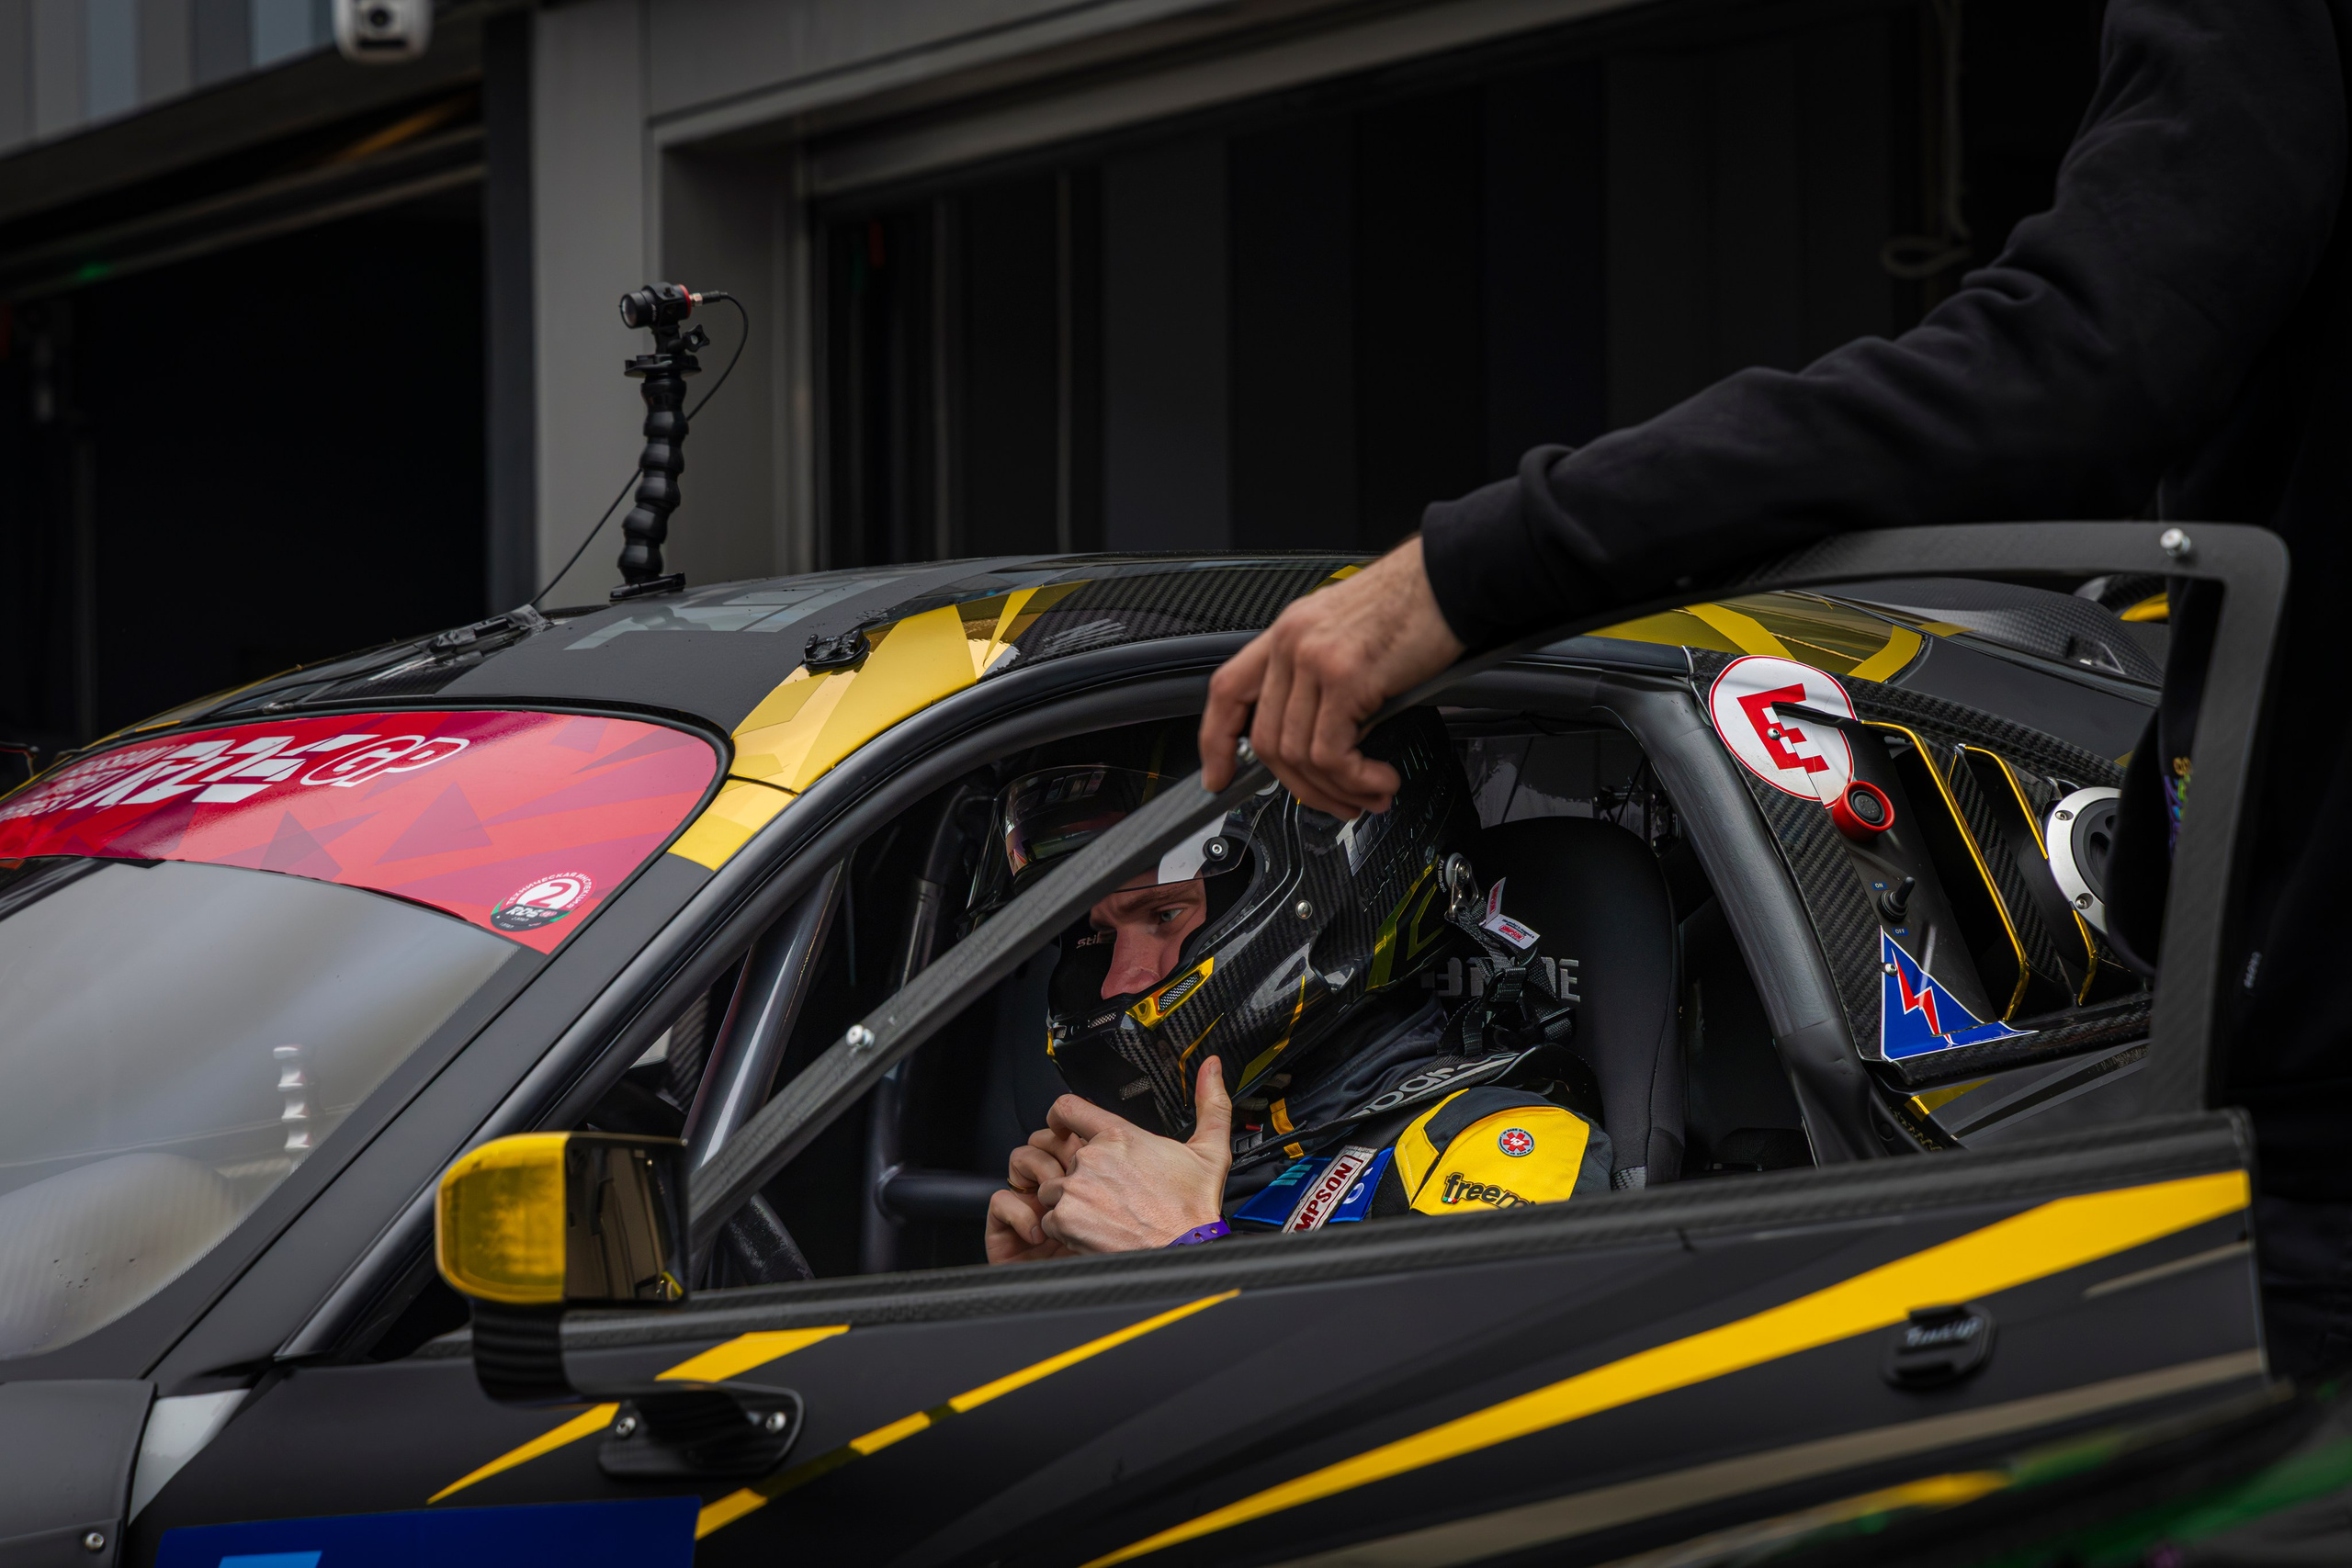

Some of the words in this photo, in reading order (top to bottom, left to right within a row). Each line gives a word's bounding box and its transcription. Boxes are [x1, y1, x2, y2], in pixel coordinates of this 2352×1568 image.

[1736, 683, 1830, 773] E
[300, 735, 470, 788] GP
[505, 872, 578, 906] ТЕХНИЧЕСКАЯ
[566, 873, 593, 908] ИНСПЕКЦИЯ
[524, 882, 572, 908] 2
[505, 906, 545, 918] RDS
[1076, 931, 1101, 949] Stil
[1294, 1162, 1354, 1231] MPSON
